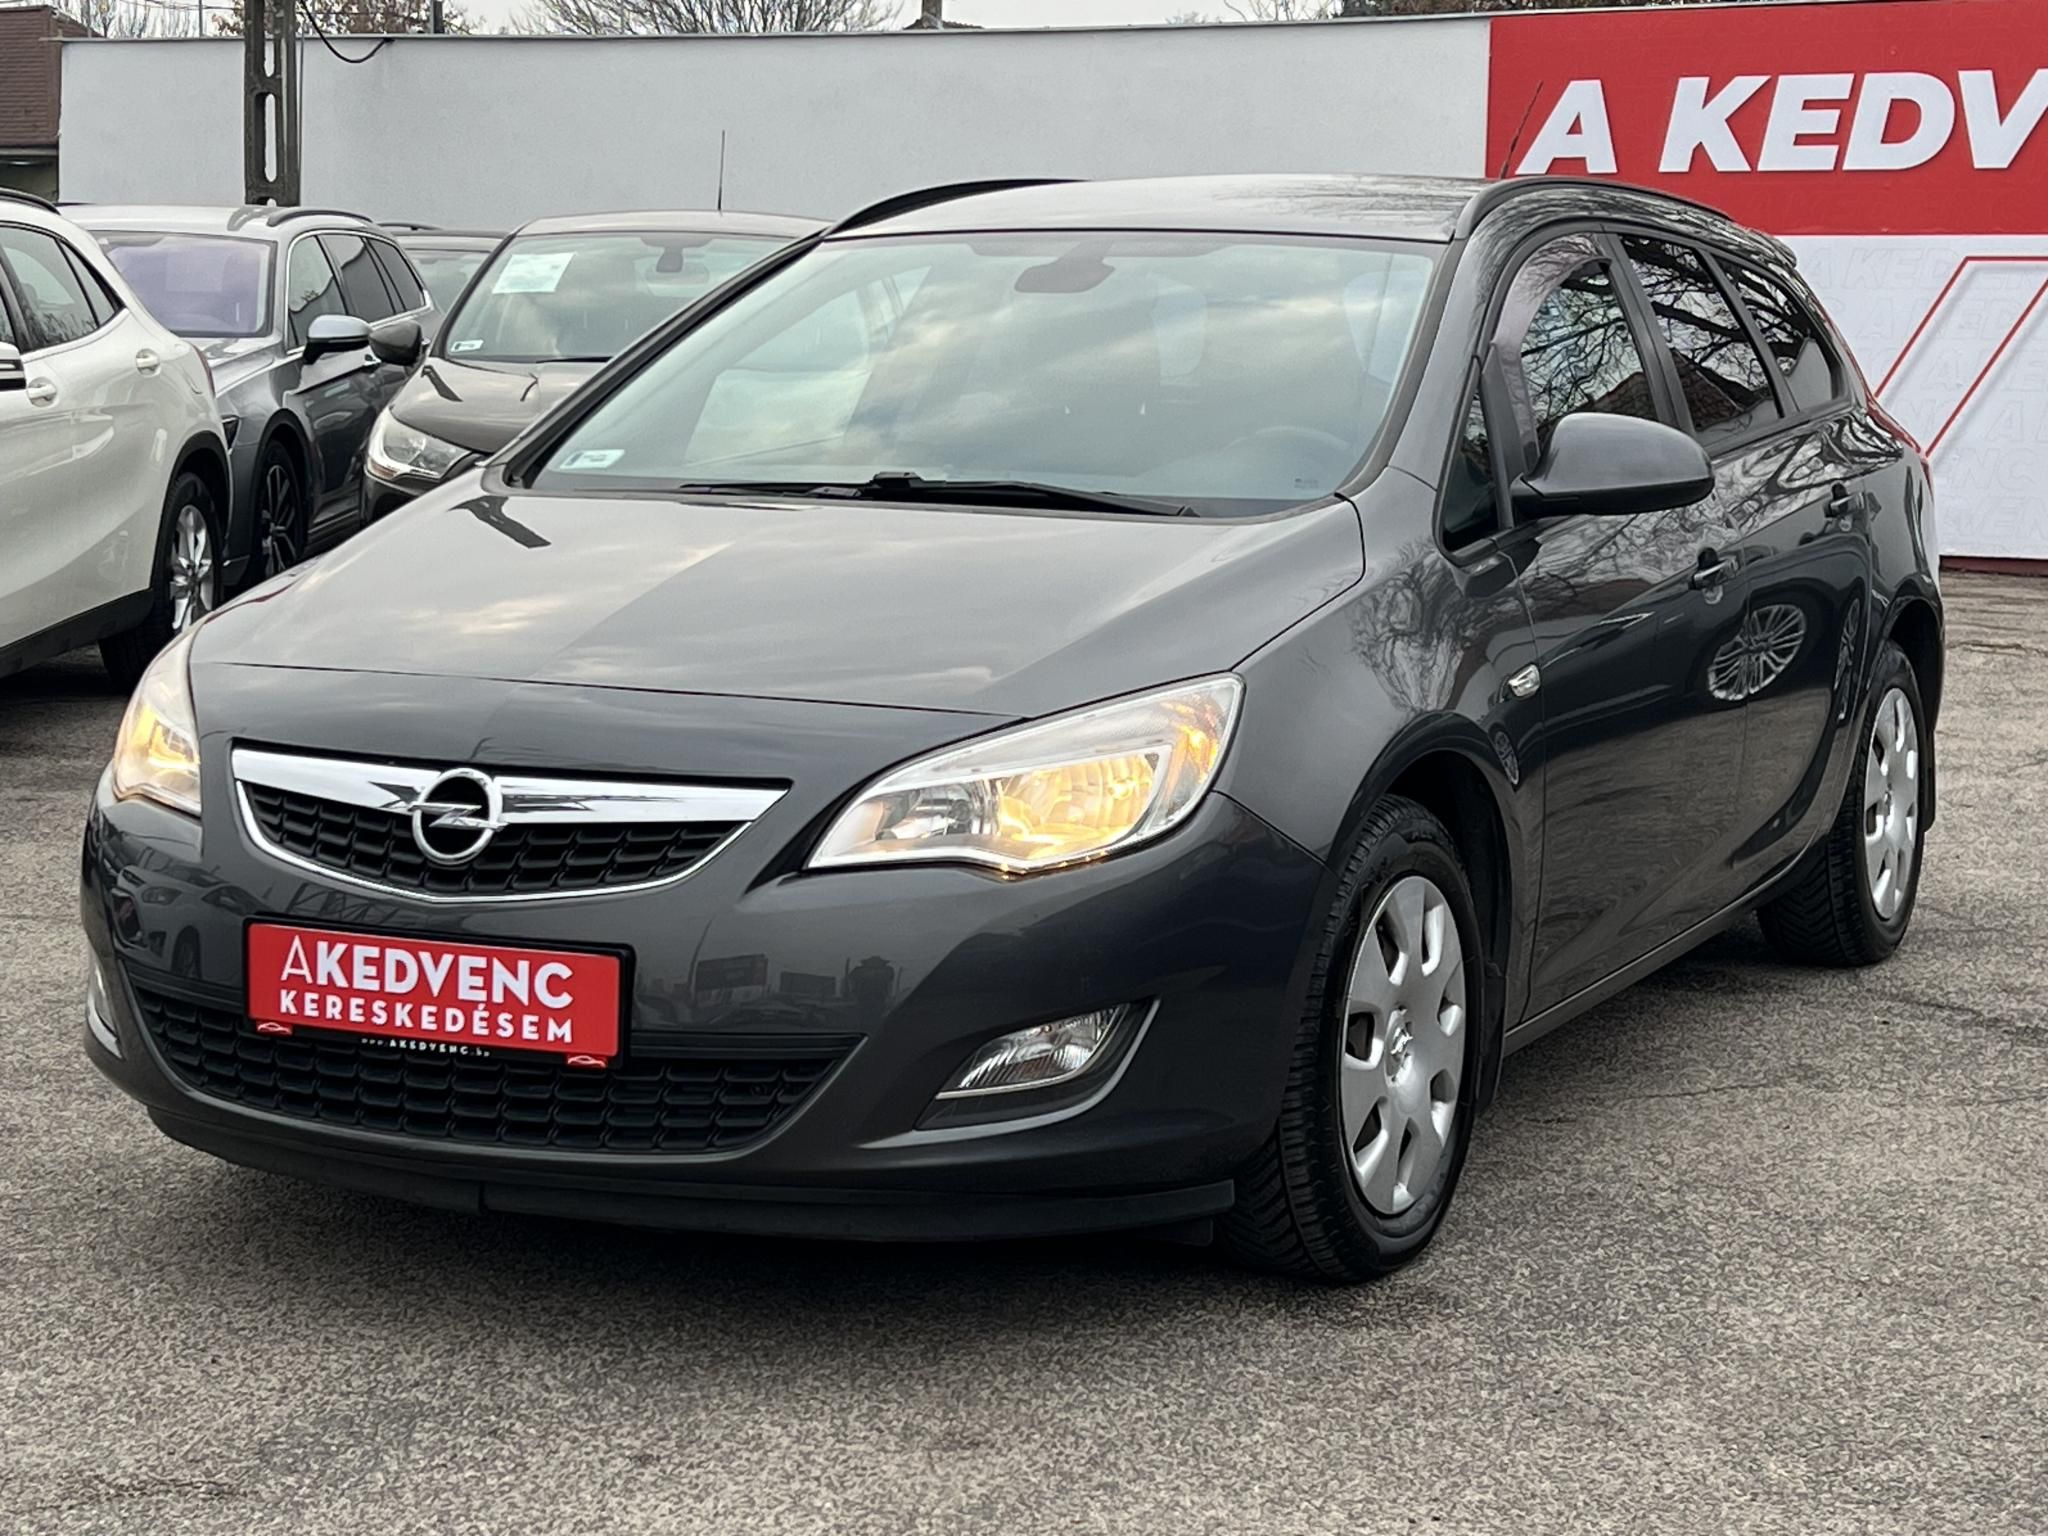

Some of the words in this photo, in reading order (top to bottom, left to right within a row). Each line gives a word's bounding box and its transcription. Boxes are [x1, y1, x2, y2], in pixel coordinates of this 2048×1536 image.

[1516, 79, 1617, 174] A
[1659, 68, 2048, 173] KEDV
[279, 989, 573, 1043] KERESKEDÉSEM
